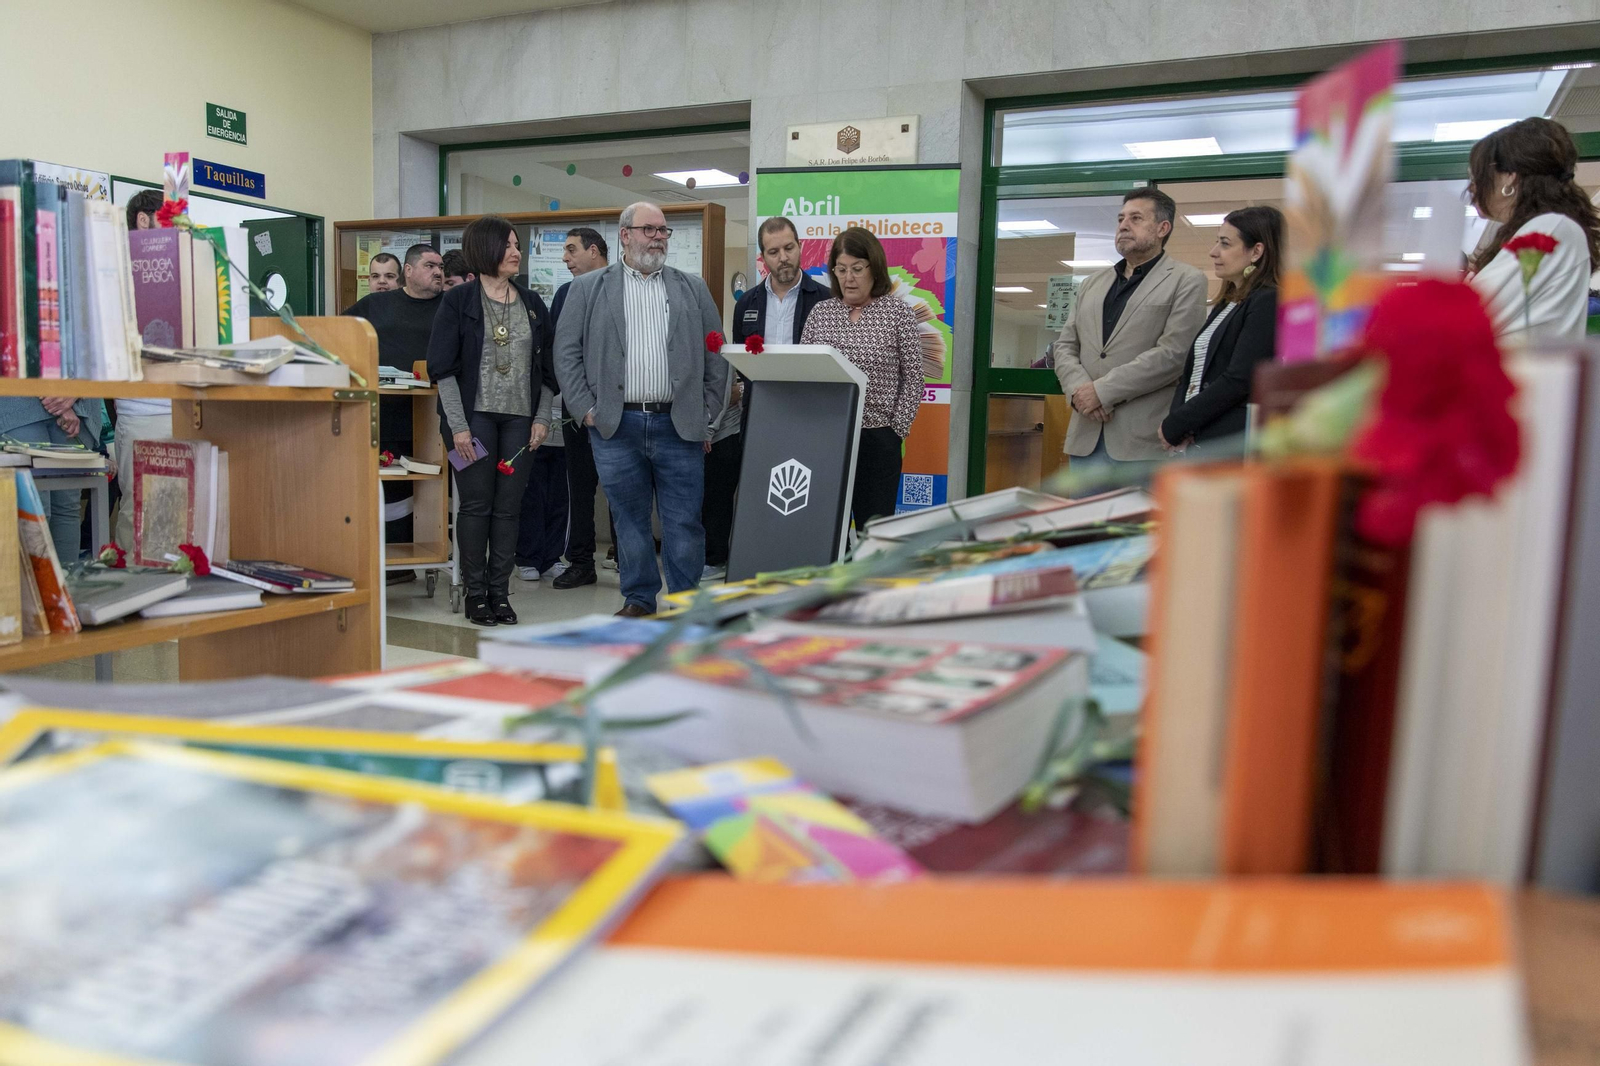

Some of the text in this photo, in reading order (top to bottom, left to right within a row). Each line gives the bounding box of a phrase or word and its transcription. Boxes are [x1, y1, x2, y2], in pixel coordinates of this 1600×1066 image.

[215, 107, 238, 121] SALIDA
[222, 119, 232, 130] DE
[207, 125, 247, 142] EMERGENCIA
[828, 158, 840, 166] Don
[841, 156, 858, 166] Felipe
[860, 156, 867, 164] de
[868, 154, 890, 163] Borbón
[203, 165, 256, 190] Taquillas
[781, 194, 840, 216] Abril
[806, 226, 824, 236] en
[828, 223, 841, 236] la
[131, 257, 175, 272] STOLOGIA
